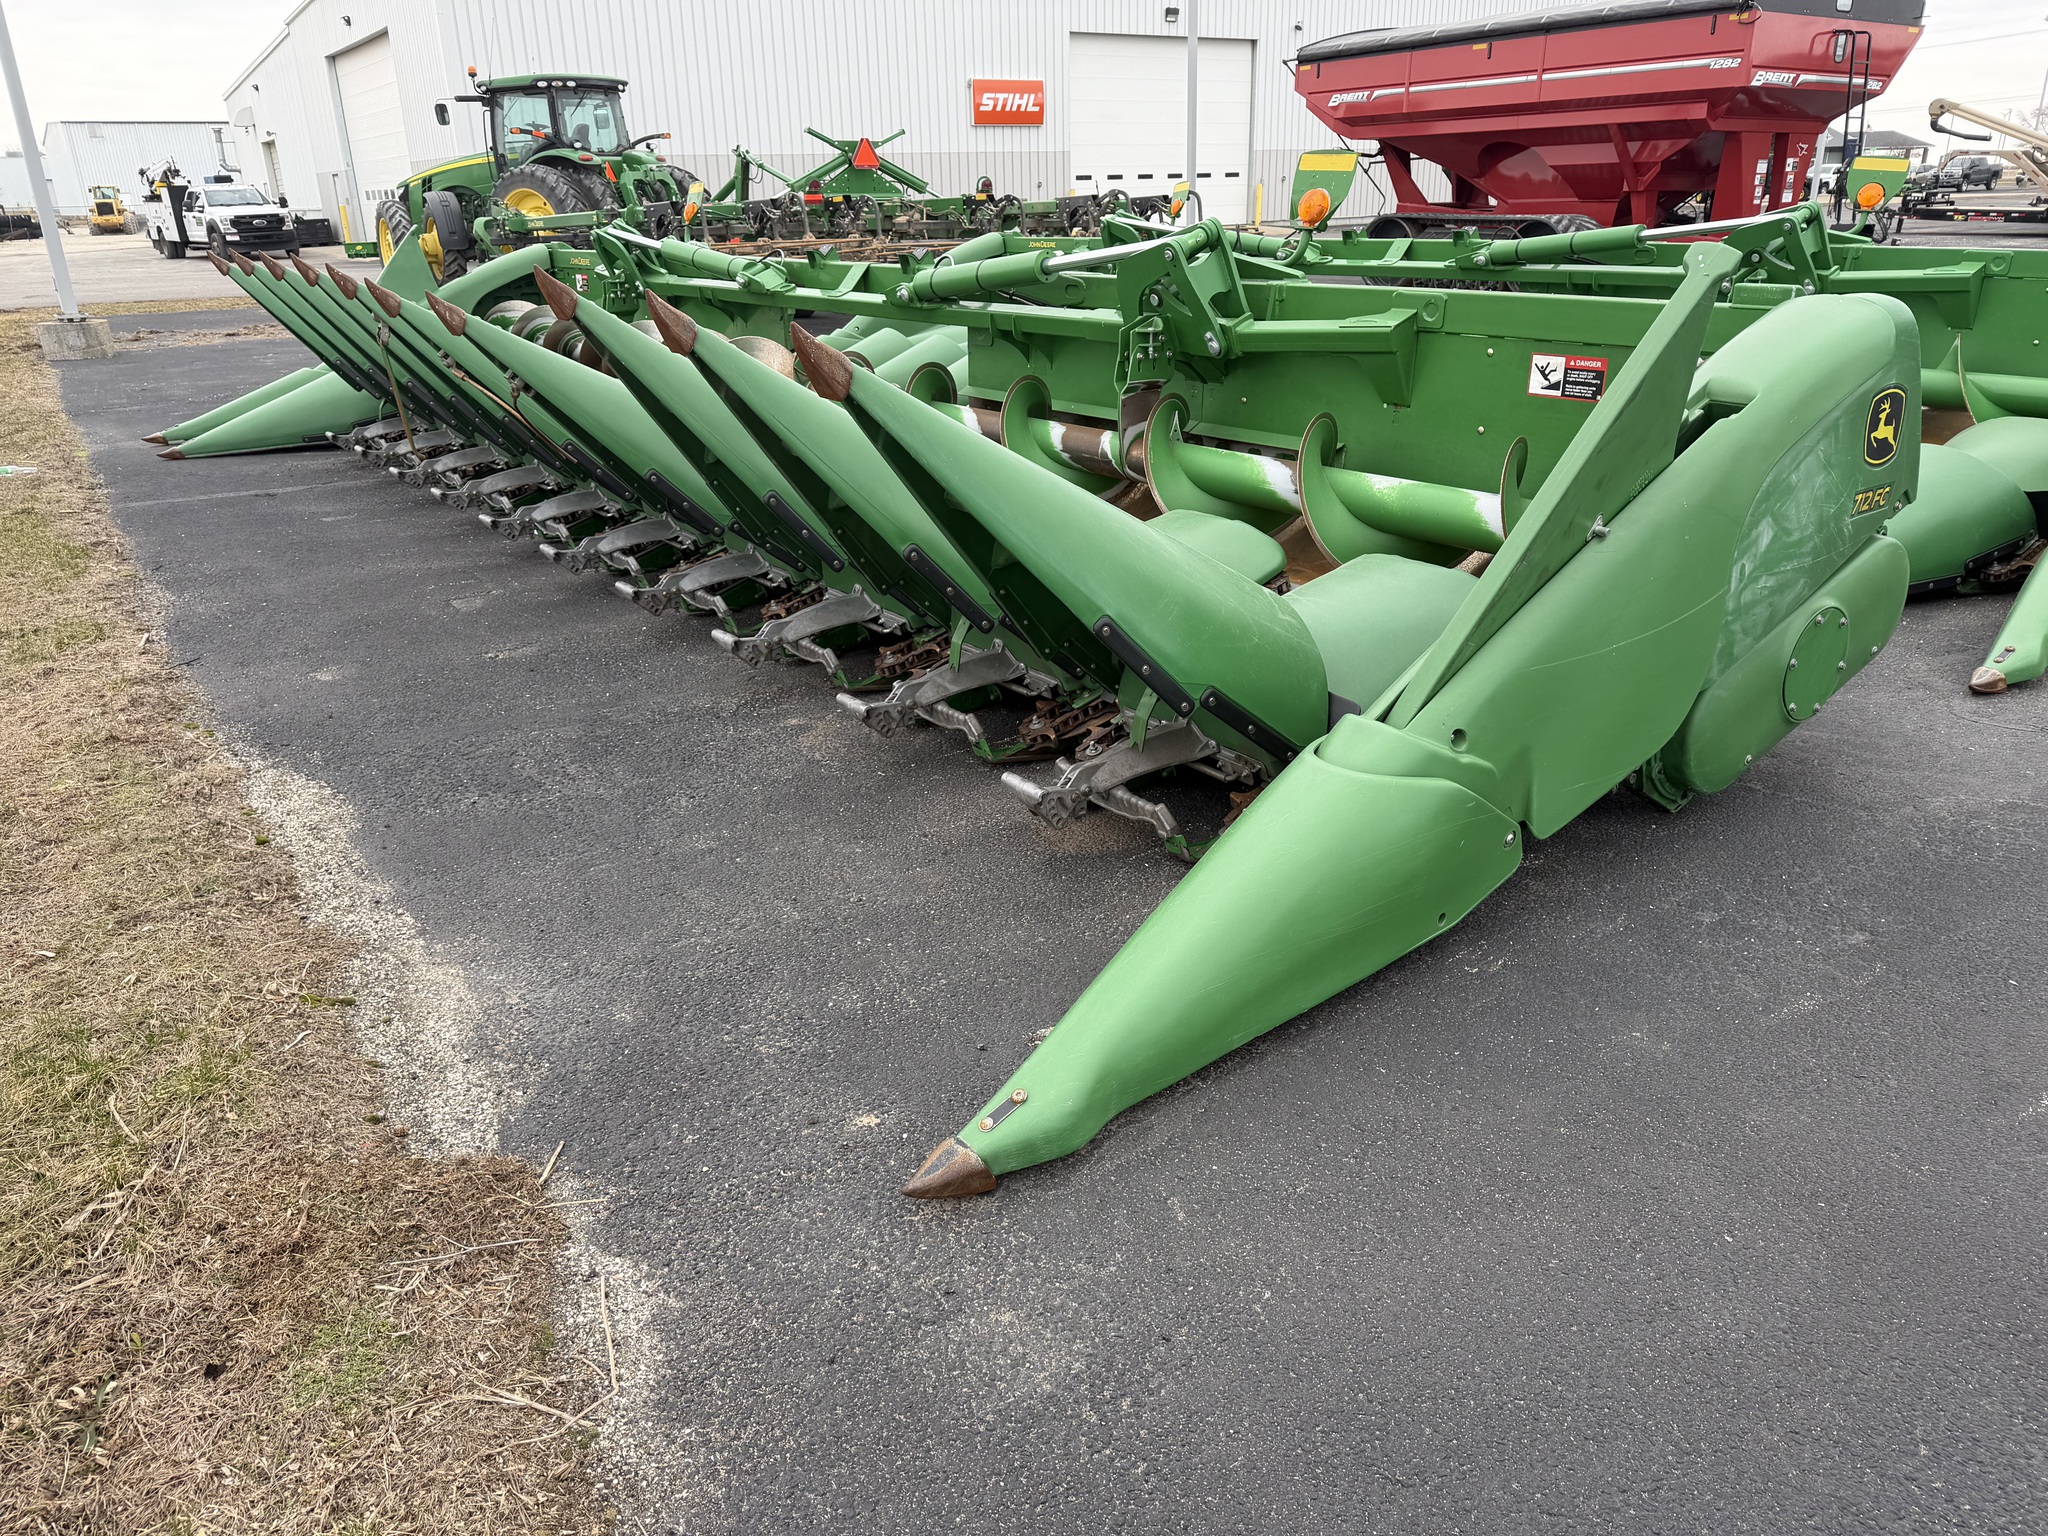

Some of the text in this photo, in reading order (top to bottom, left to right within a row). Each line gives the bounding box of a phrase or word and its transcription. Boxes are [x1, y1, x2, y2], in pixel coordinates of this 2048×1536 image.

[1709, 58, 1742, 70] 1282
[1750, 70, 1797, 86] BRENT
[1867, 81, 1883, 90] 282
[979, 92, 1041, 112] STIHL
[1327, 90, 1371, 107] BRENT
[1575, 359, 1602, 368] DANGER
